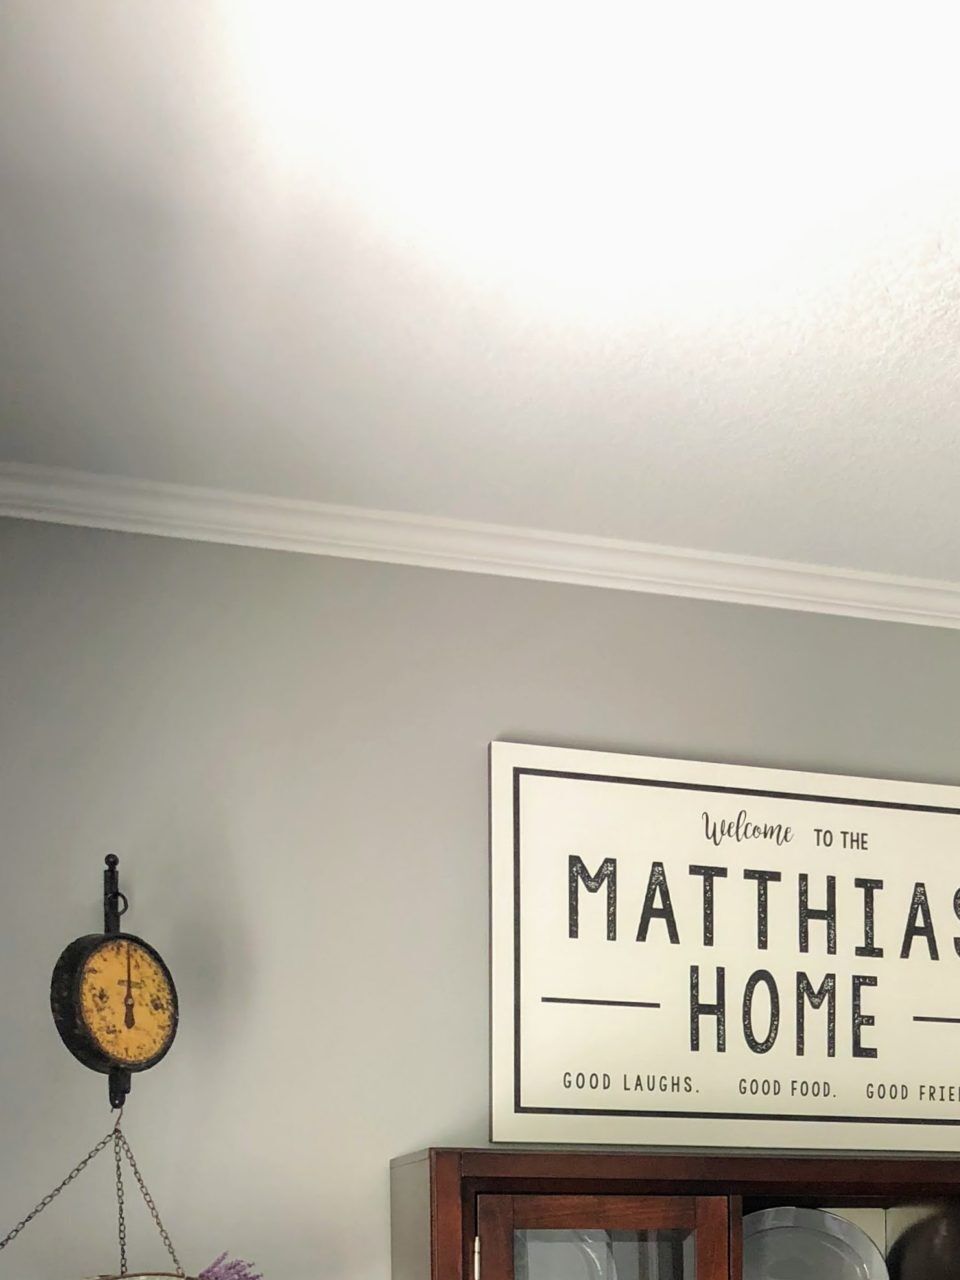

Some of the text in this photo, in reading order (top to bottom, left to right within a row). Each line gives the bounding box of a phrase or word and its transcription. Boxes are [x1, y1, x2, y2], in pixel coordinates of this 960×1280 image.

[701, 809, 869, 851] Welcome TO THE
[689, 965, 879, 1059] HOME
[562, 1071, 612, 1091] GOOD
[622, 1074, 700, 1094] LAUGHS.
[737, 1078, 782, 1097] GOOD
[790, 1080, 837, 1098] FOOD.
[865, 1082, 910, 1101] GOOD
